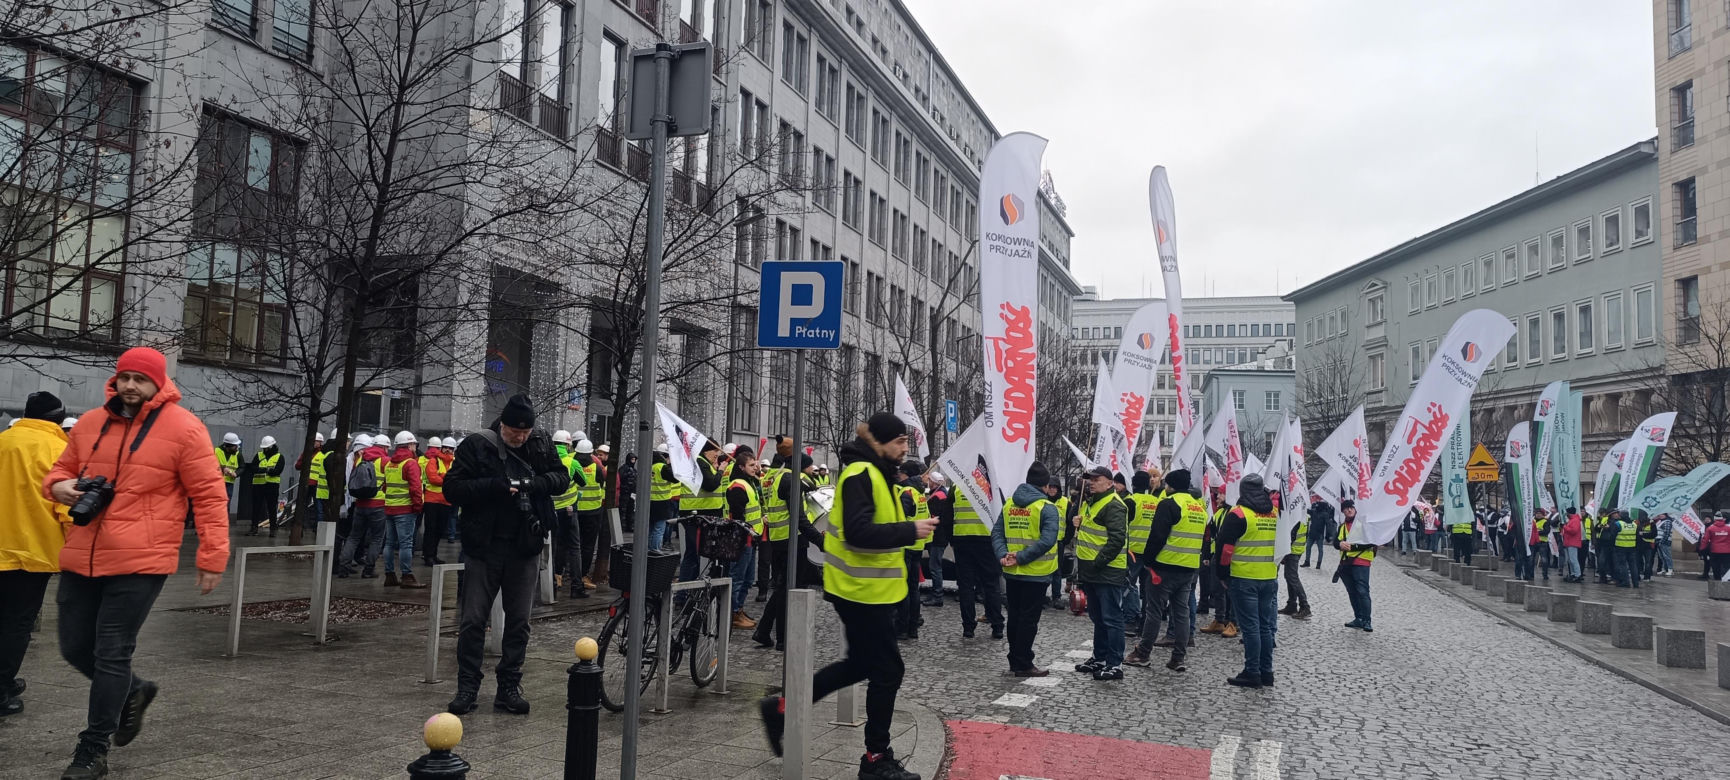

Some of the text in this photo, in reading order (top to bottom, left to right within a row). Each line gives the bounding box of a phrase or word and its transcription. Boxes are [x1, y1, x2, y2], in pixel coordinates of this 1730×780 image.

[778, 272, 825, 337] P
[795, 326, 835, 341] Płatny
[948, 403, 955, 422] P
[984, 381, 994, 428] OM NSZZ
[947, 459, 965, 480] REGION
[1338, 453, 1359, 475] KOKSOW
